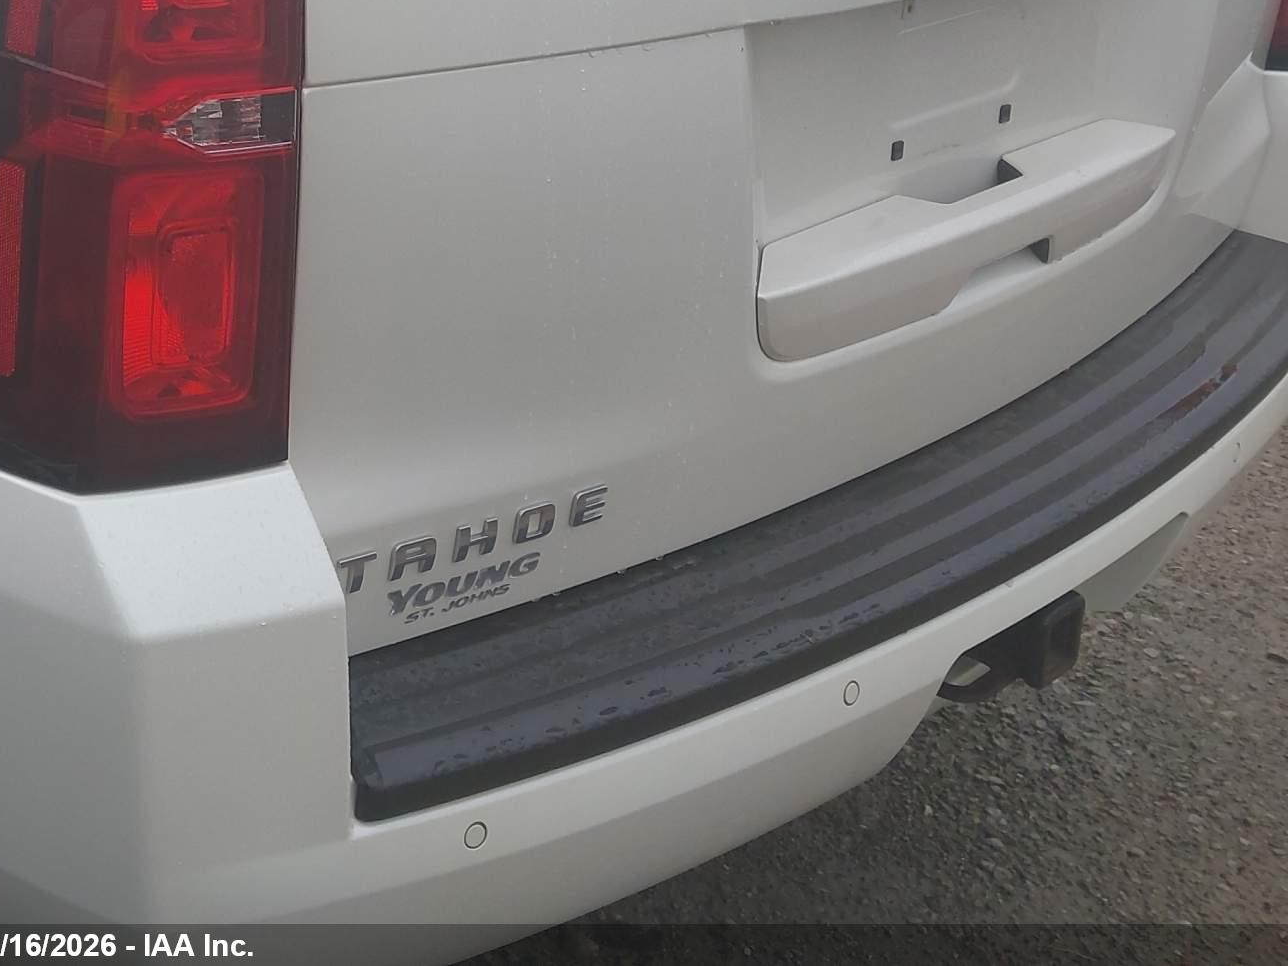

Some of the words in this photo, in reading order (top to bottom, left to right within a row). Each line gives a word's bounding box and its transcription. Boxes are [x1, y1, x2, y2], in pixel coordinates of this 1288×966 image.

[336, 484, 608, 594] TAHOE
[387, 552, 540, 616] YOUNG
[404, 607, 435, 624] ST.
[441, 584, 510, 613] JOHNS
